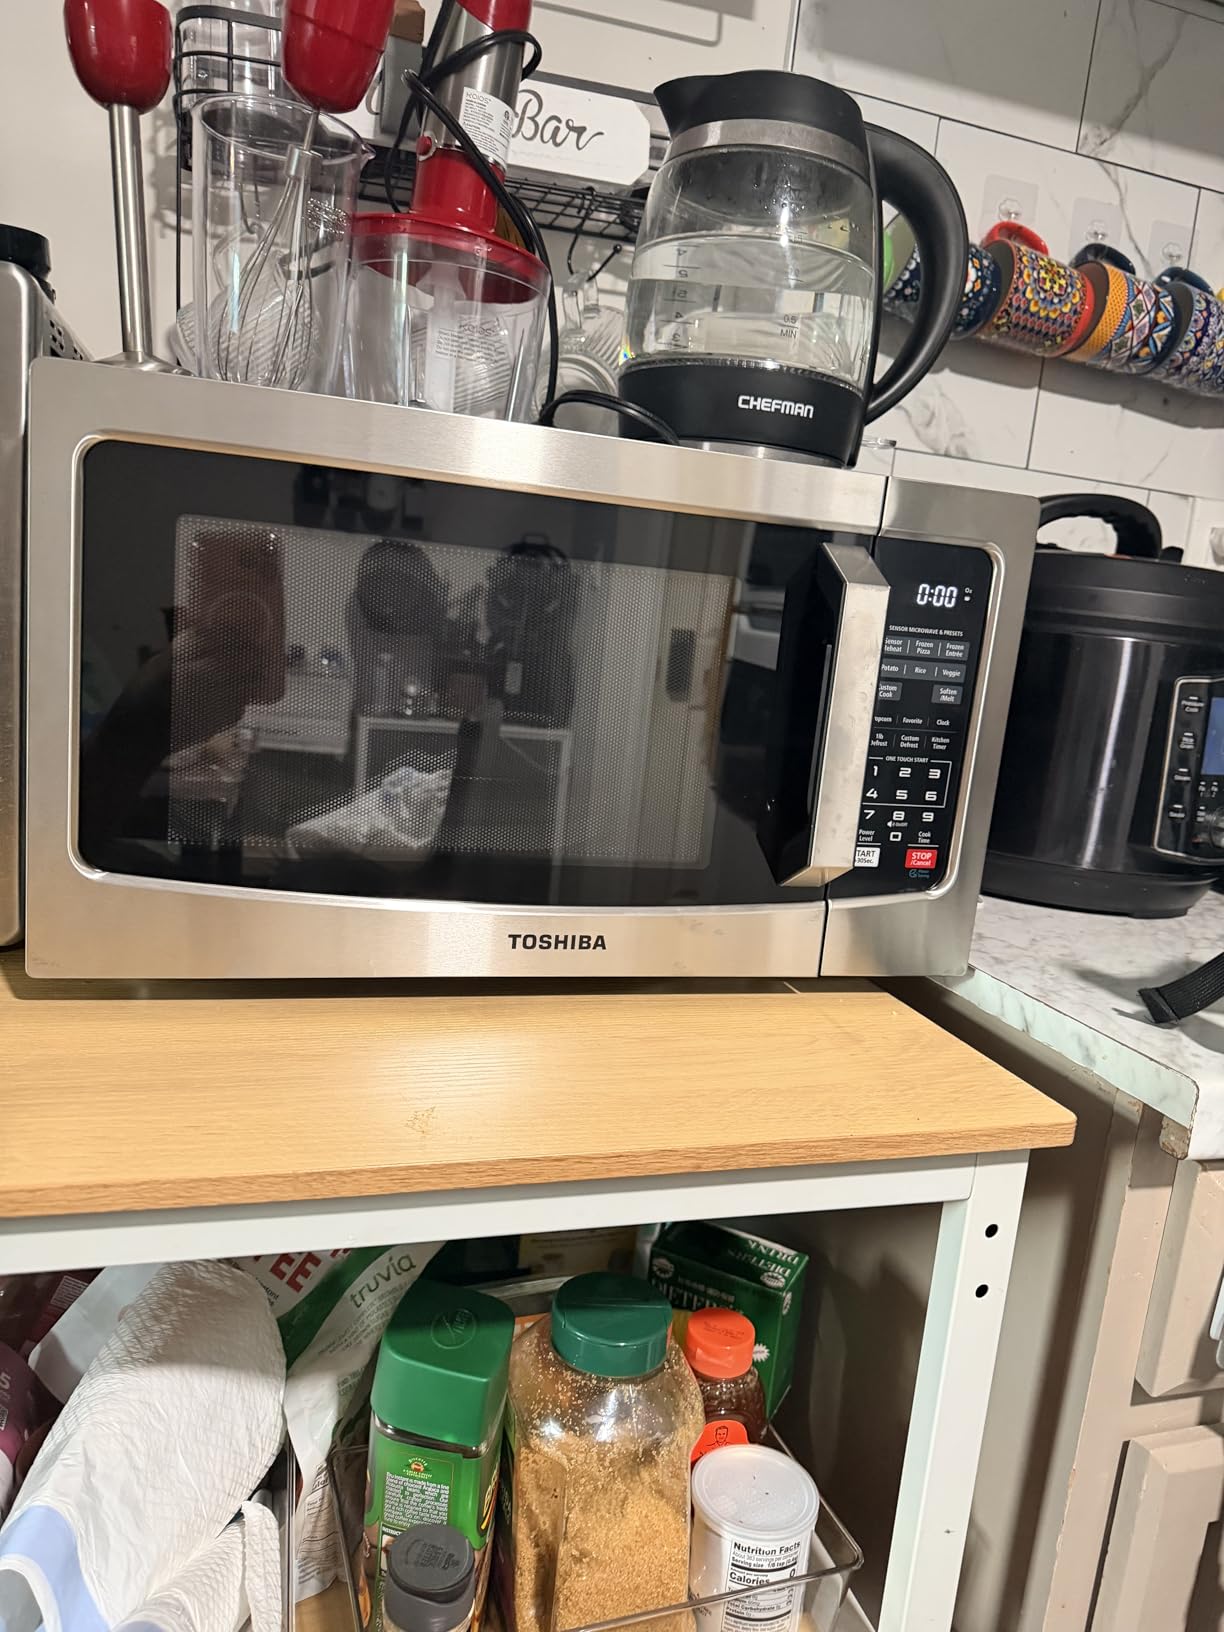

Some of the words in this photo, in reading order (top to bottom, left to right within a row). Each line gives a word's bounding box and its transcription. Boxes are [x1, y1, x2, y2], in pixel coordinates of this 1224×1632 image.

[511, 89, 604, 150] Bar
[784, 314, 797, 324] 0.5
[780, 328, 797, 338] MIN
[738, 394, 814, 418] CHEFMAN
[916, 584, 958, 608] 0:00
[909, 627, 938, 635] MICROWAVE
[881, 664, 899, 672] Potato
[942, 669, 960, 678] Veggie
[873, 765, 878, 776] 1
[899, 768, 911, 777] 2
[928, 769, 941, 779] 3
[866, 788, 878, 799] 4
[896, 790, 908, 800] 5
[925, 791, 937, 801] 6
[864, 810, 875, 819] 7
[893, 811, 905, 820] 8
[922, 812, 934, 822] 9
[890, 832, 902, 841] 0
[508, 934, 606, 950] TOSHIBA
[733, 1542, 776, 1555] Nutrition
[779, 1541, 800, 1554] Facts
[732, 1556, 752, 1567] Serving
[730, 1572, 770, 1585] Calories
